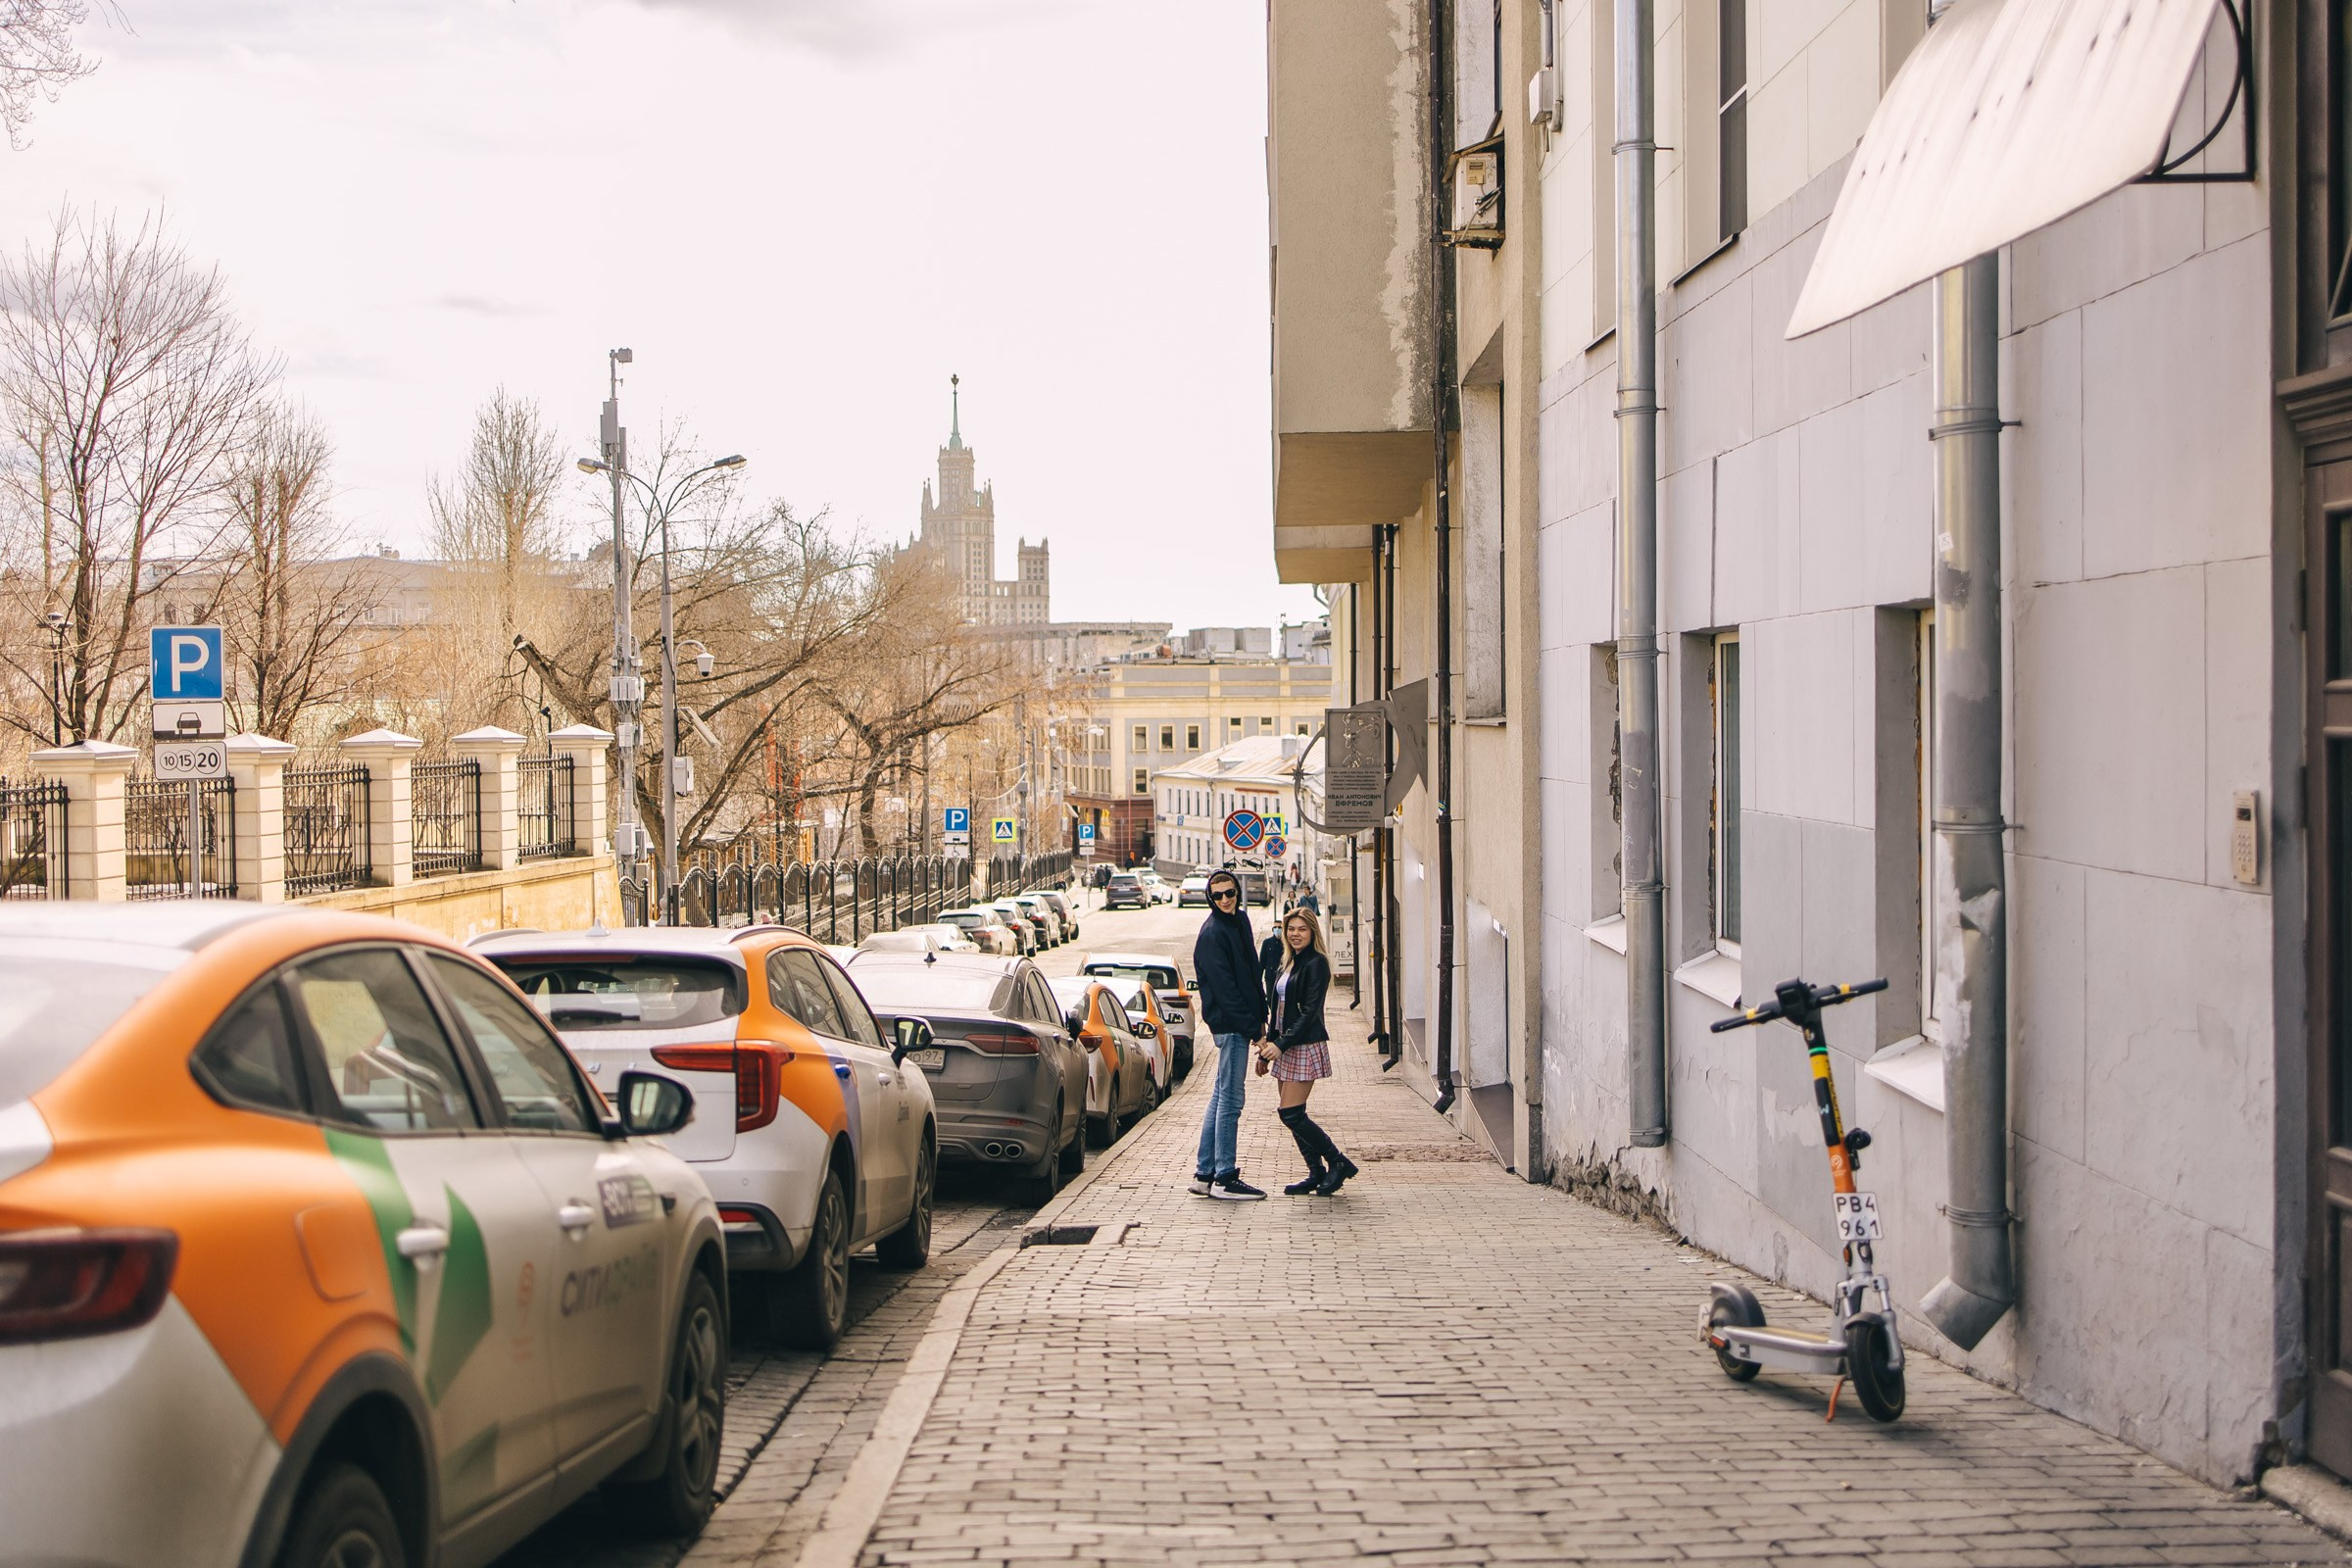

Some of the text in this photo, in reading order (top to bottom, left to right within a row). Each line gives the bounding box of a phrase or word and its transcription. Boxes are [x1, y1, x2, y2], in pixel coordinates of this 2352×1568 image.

[171, 635, 210, 692] P
[164, 752, 219, 768] 10 15 20
[951, 810, 965, 829] P
[1082, 825, 1092, 838] P
[925, 1050, 939, 1060] 97
[1840, 1219, 1879, 1237] 961
